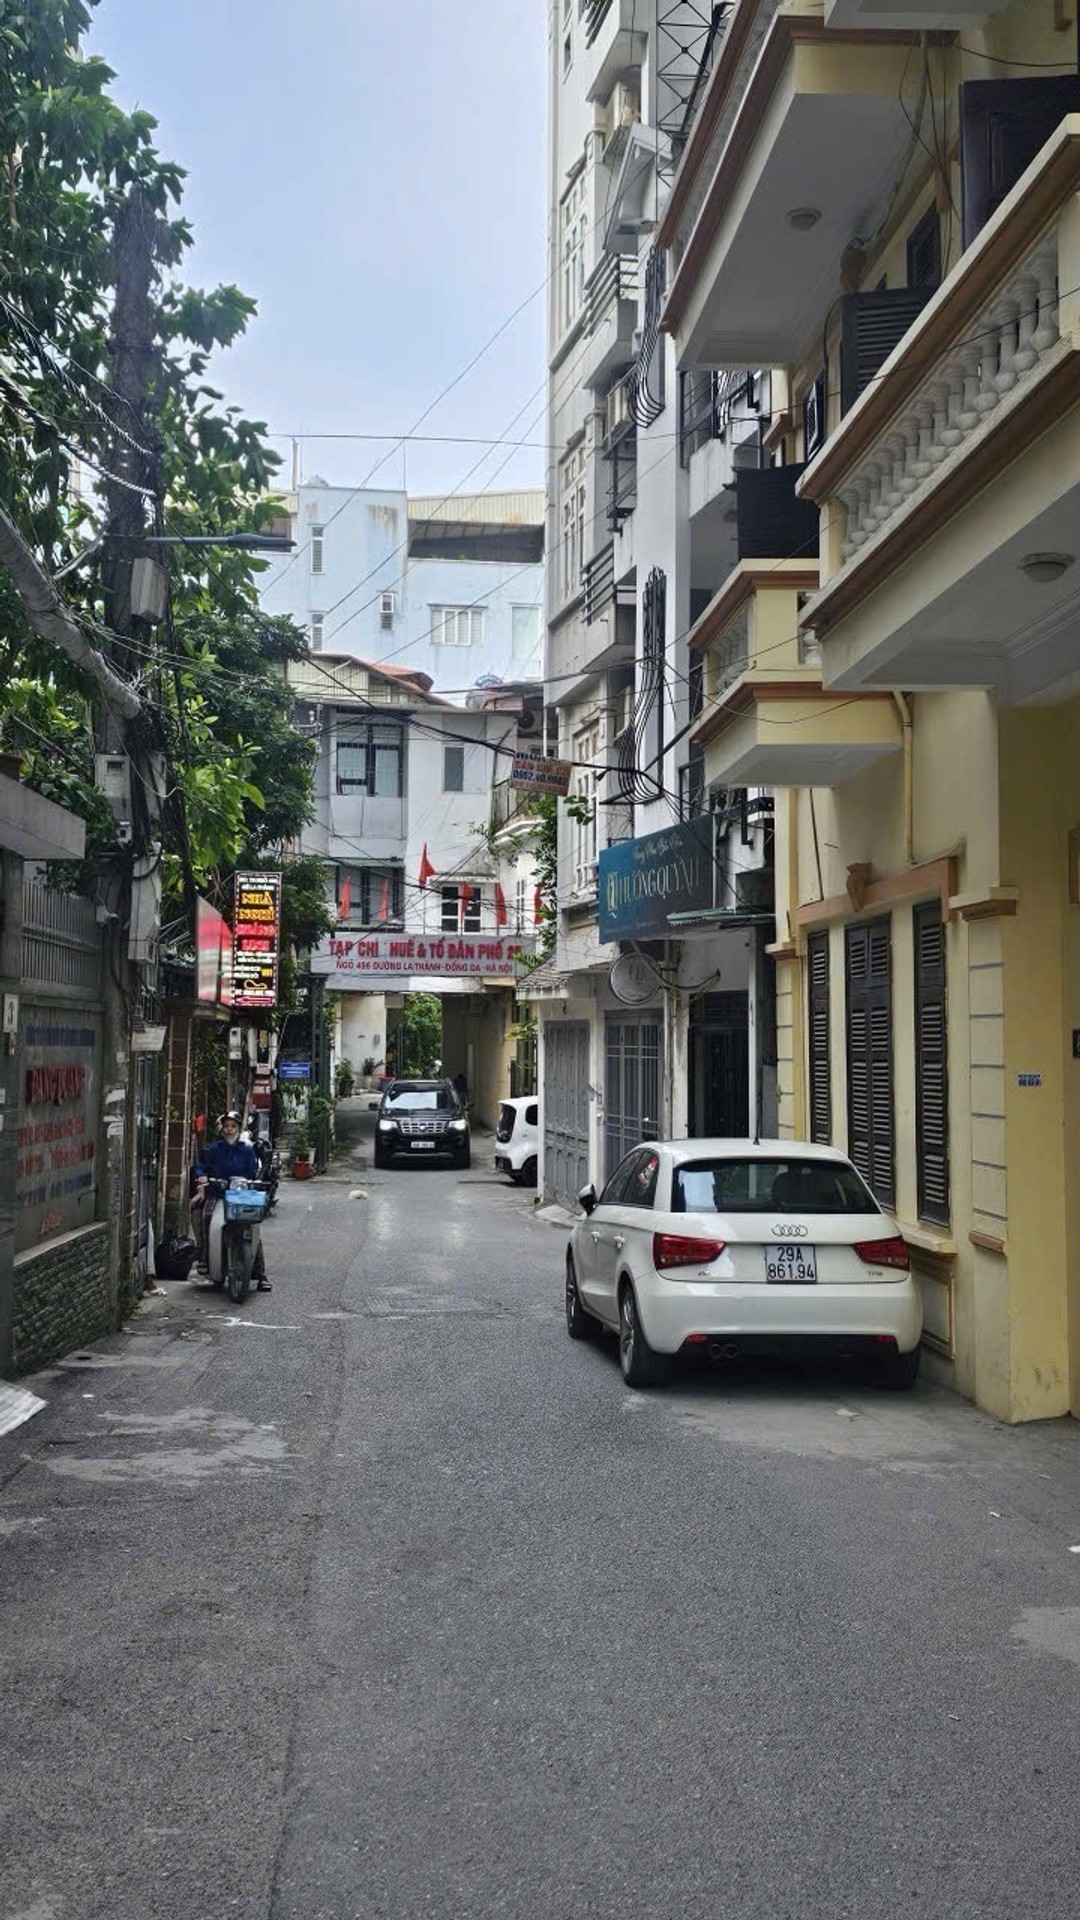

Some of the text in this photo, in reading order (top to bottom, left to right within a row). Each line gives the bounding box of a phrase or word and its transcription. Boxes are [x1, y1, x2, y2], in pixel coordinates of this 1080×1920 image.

[329, 940, 354, 960] TẠP
[417, 942, 427, 958] &
[777, 1246, 804, 1262] 29A
[767, 1263, 814, 1279] 861.94
